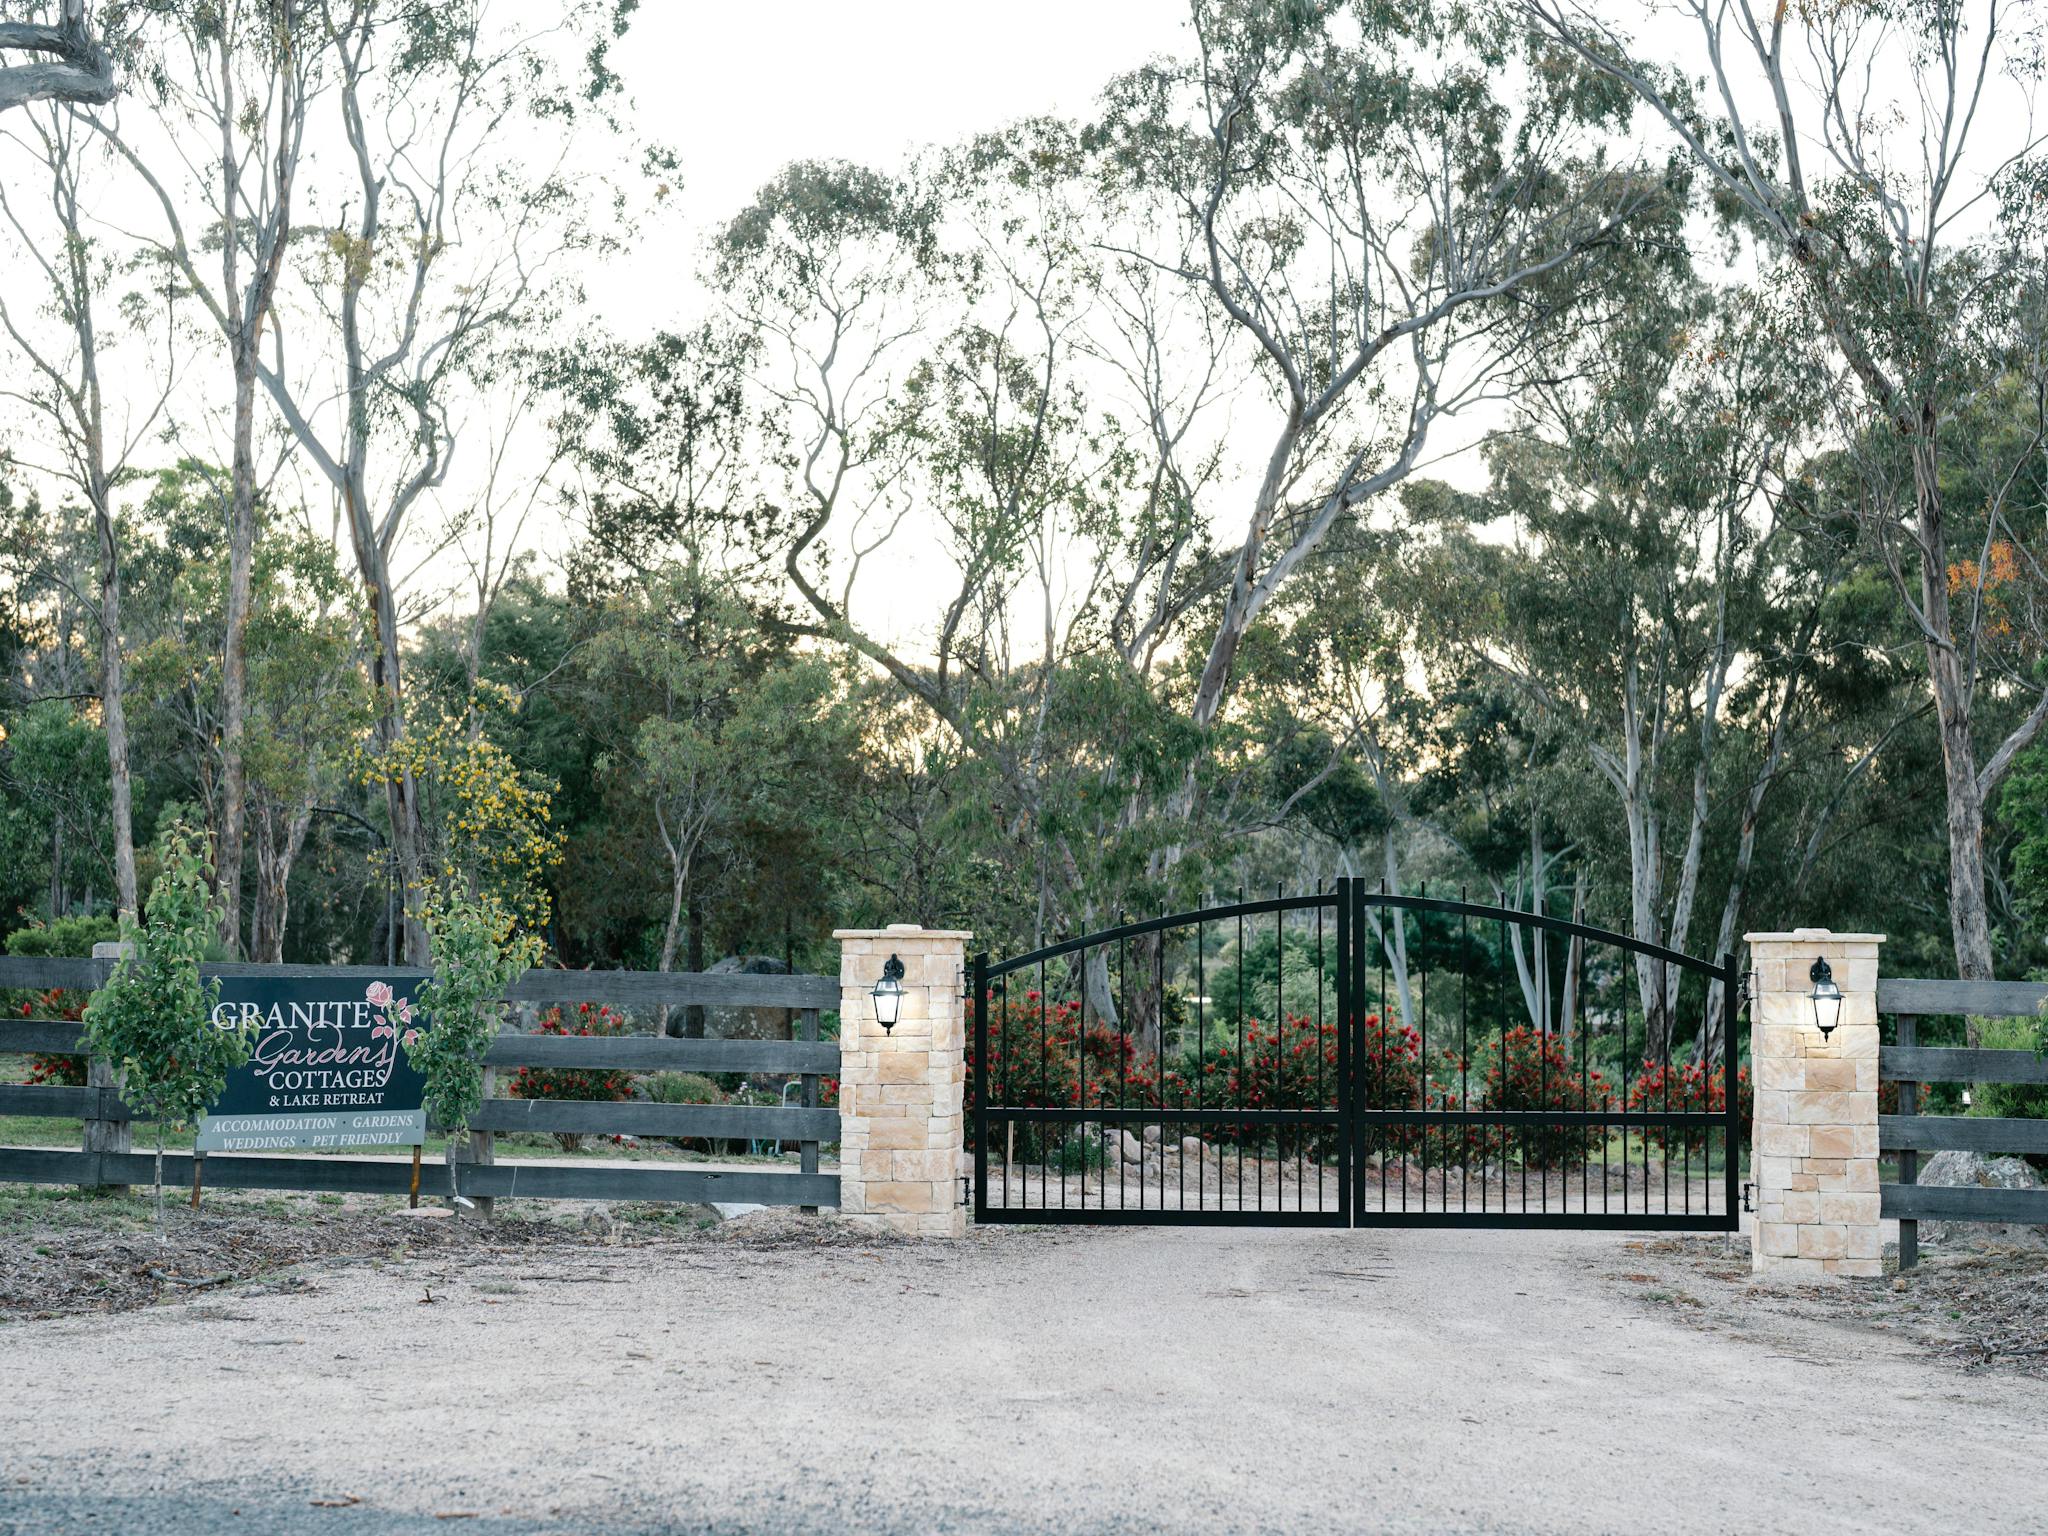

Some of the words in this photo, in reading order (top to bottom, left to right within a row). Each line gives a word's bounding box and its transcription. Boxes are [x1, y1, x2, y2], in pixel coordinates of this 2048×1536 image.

[211, 1001, 371, 1030] GRANITE
[252, 1021, 393, 1076] Gardens
[268, 1069, 386, 1090] COTTAGES
[269, 1095, 279, 1106] &
[283, 1094, 320, 1106] LAKE
[323, 1092, 384, 1105] RETREAT
[212, 1117, 337, 1133] ACCOMMODATION
[352, 1115, 413, 1128] GARDENS
[223, 1135, 296, 1150] WEDDINGS
[312, 1134, 337, 1148] PET
[340, 1131, 404, 1146] FRIENDLY
